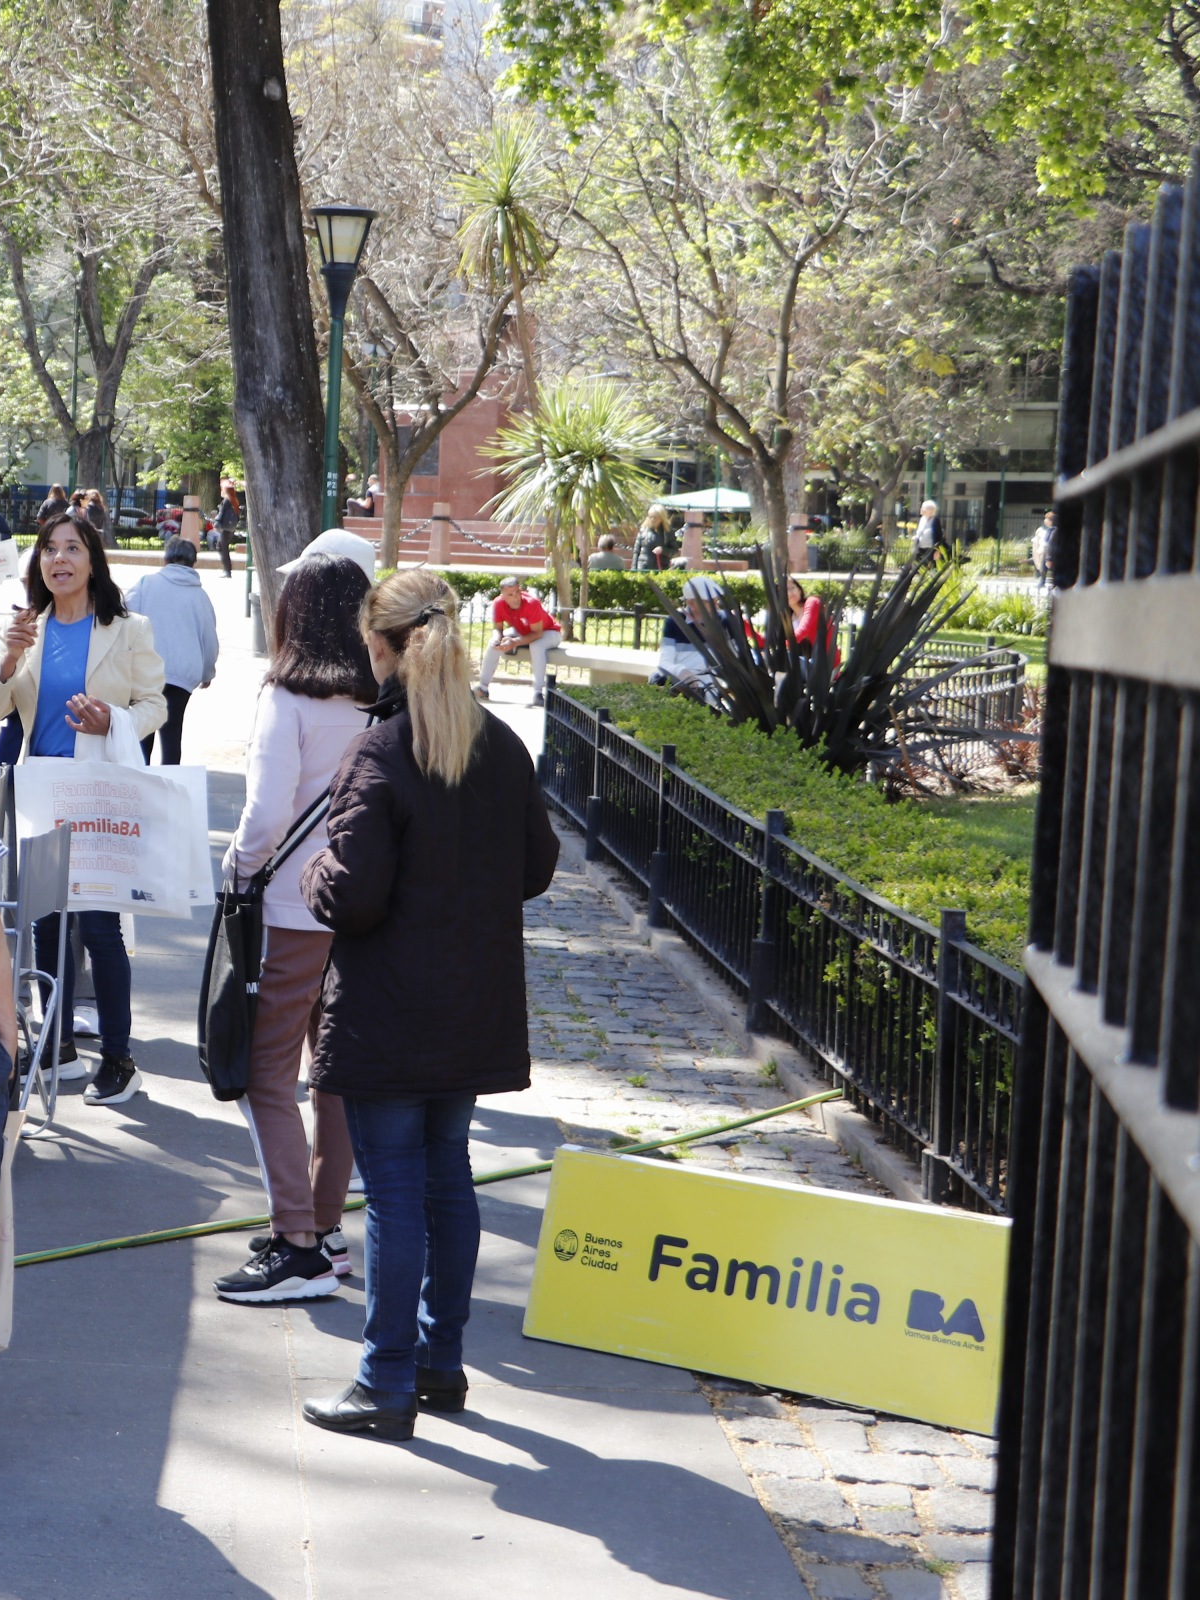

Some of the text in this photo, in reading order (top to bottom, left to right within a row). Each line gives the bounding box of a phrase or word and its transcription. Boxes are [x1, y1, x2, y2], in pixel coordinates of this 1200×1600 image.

[52, 781, 142, 800] FamiliaBA
[53, 799, 142, 820] FamiliaBA
[70, 836, 139, 857] amiliaBA
[69, 855, 139, 875] amiliaBA
[584, 1232, 623, 1249] Buenos
[582, 1244, 611, 1258] Aires
[580, 1255, 619, 1271] Ciudad
[648, 1233, 985, 1343] Familia BA
[904, 1328, 985, 1352] Vamos Buenos Aires
